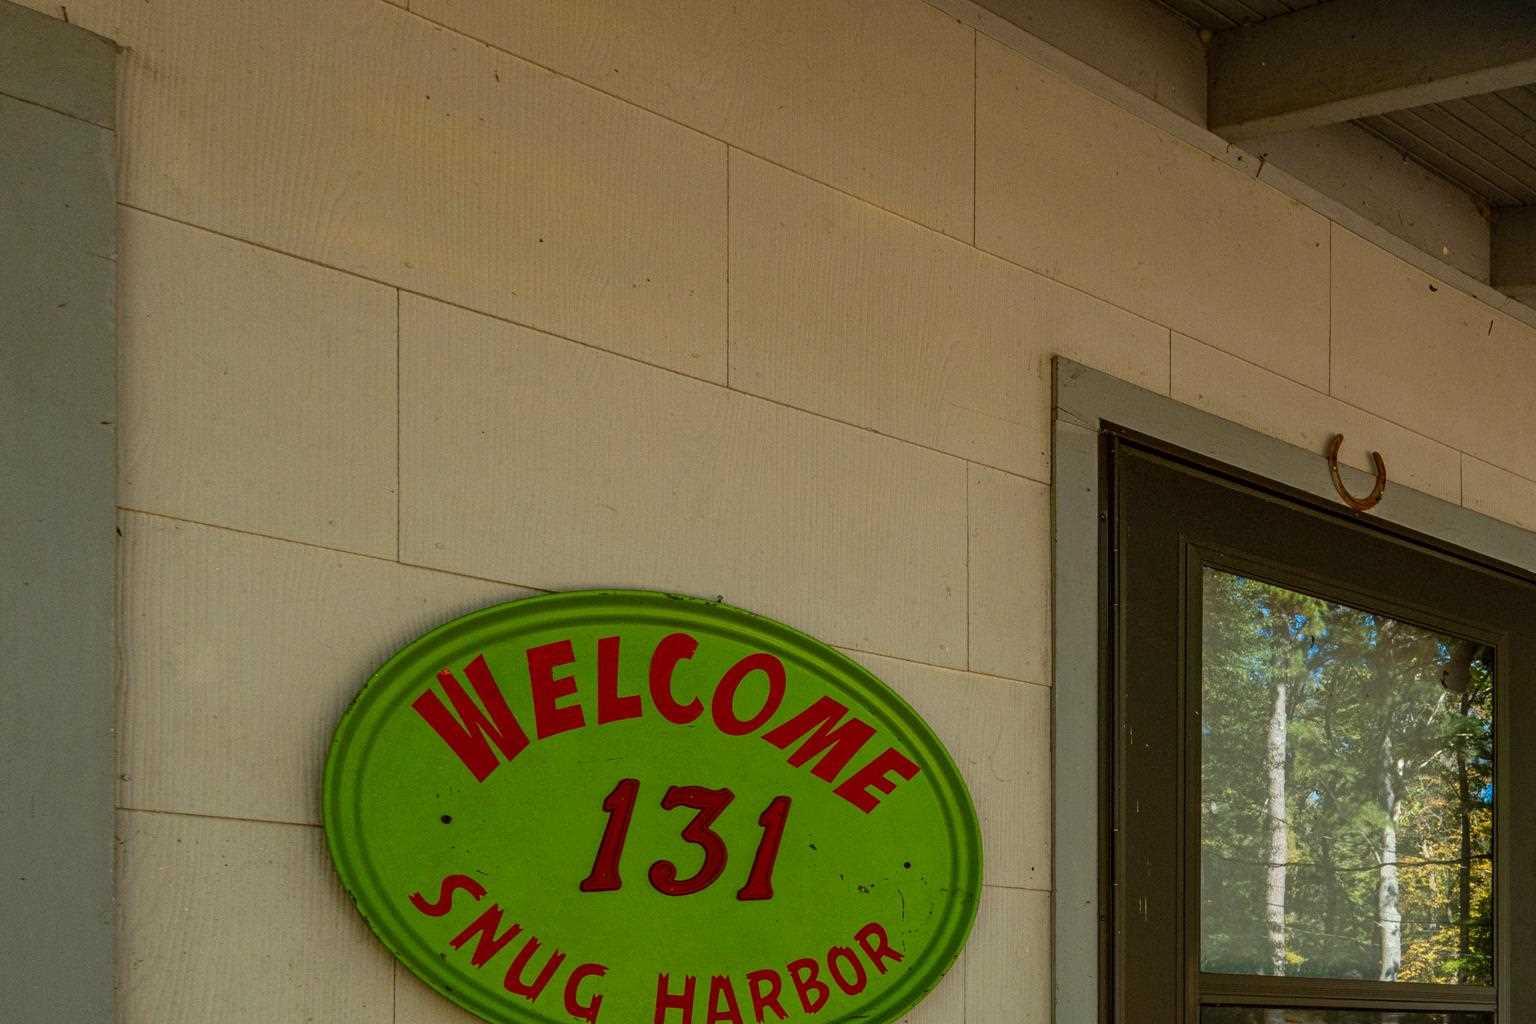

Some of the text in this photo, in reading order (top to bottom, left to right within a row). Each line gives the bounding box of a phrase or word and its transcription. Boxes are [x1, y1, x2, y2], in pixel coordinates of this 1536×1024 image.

[411, 632, 921, 814] WELCOME
[579, 778, 793, 901] 131
[408, 874, 608, 1024] SNUG
